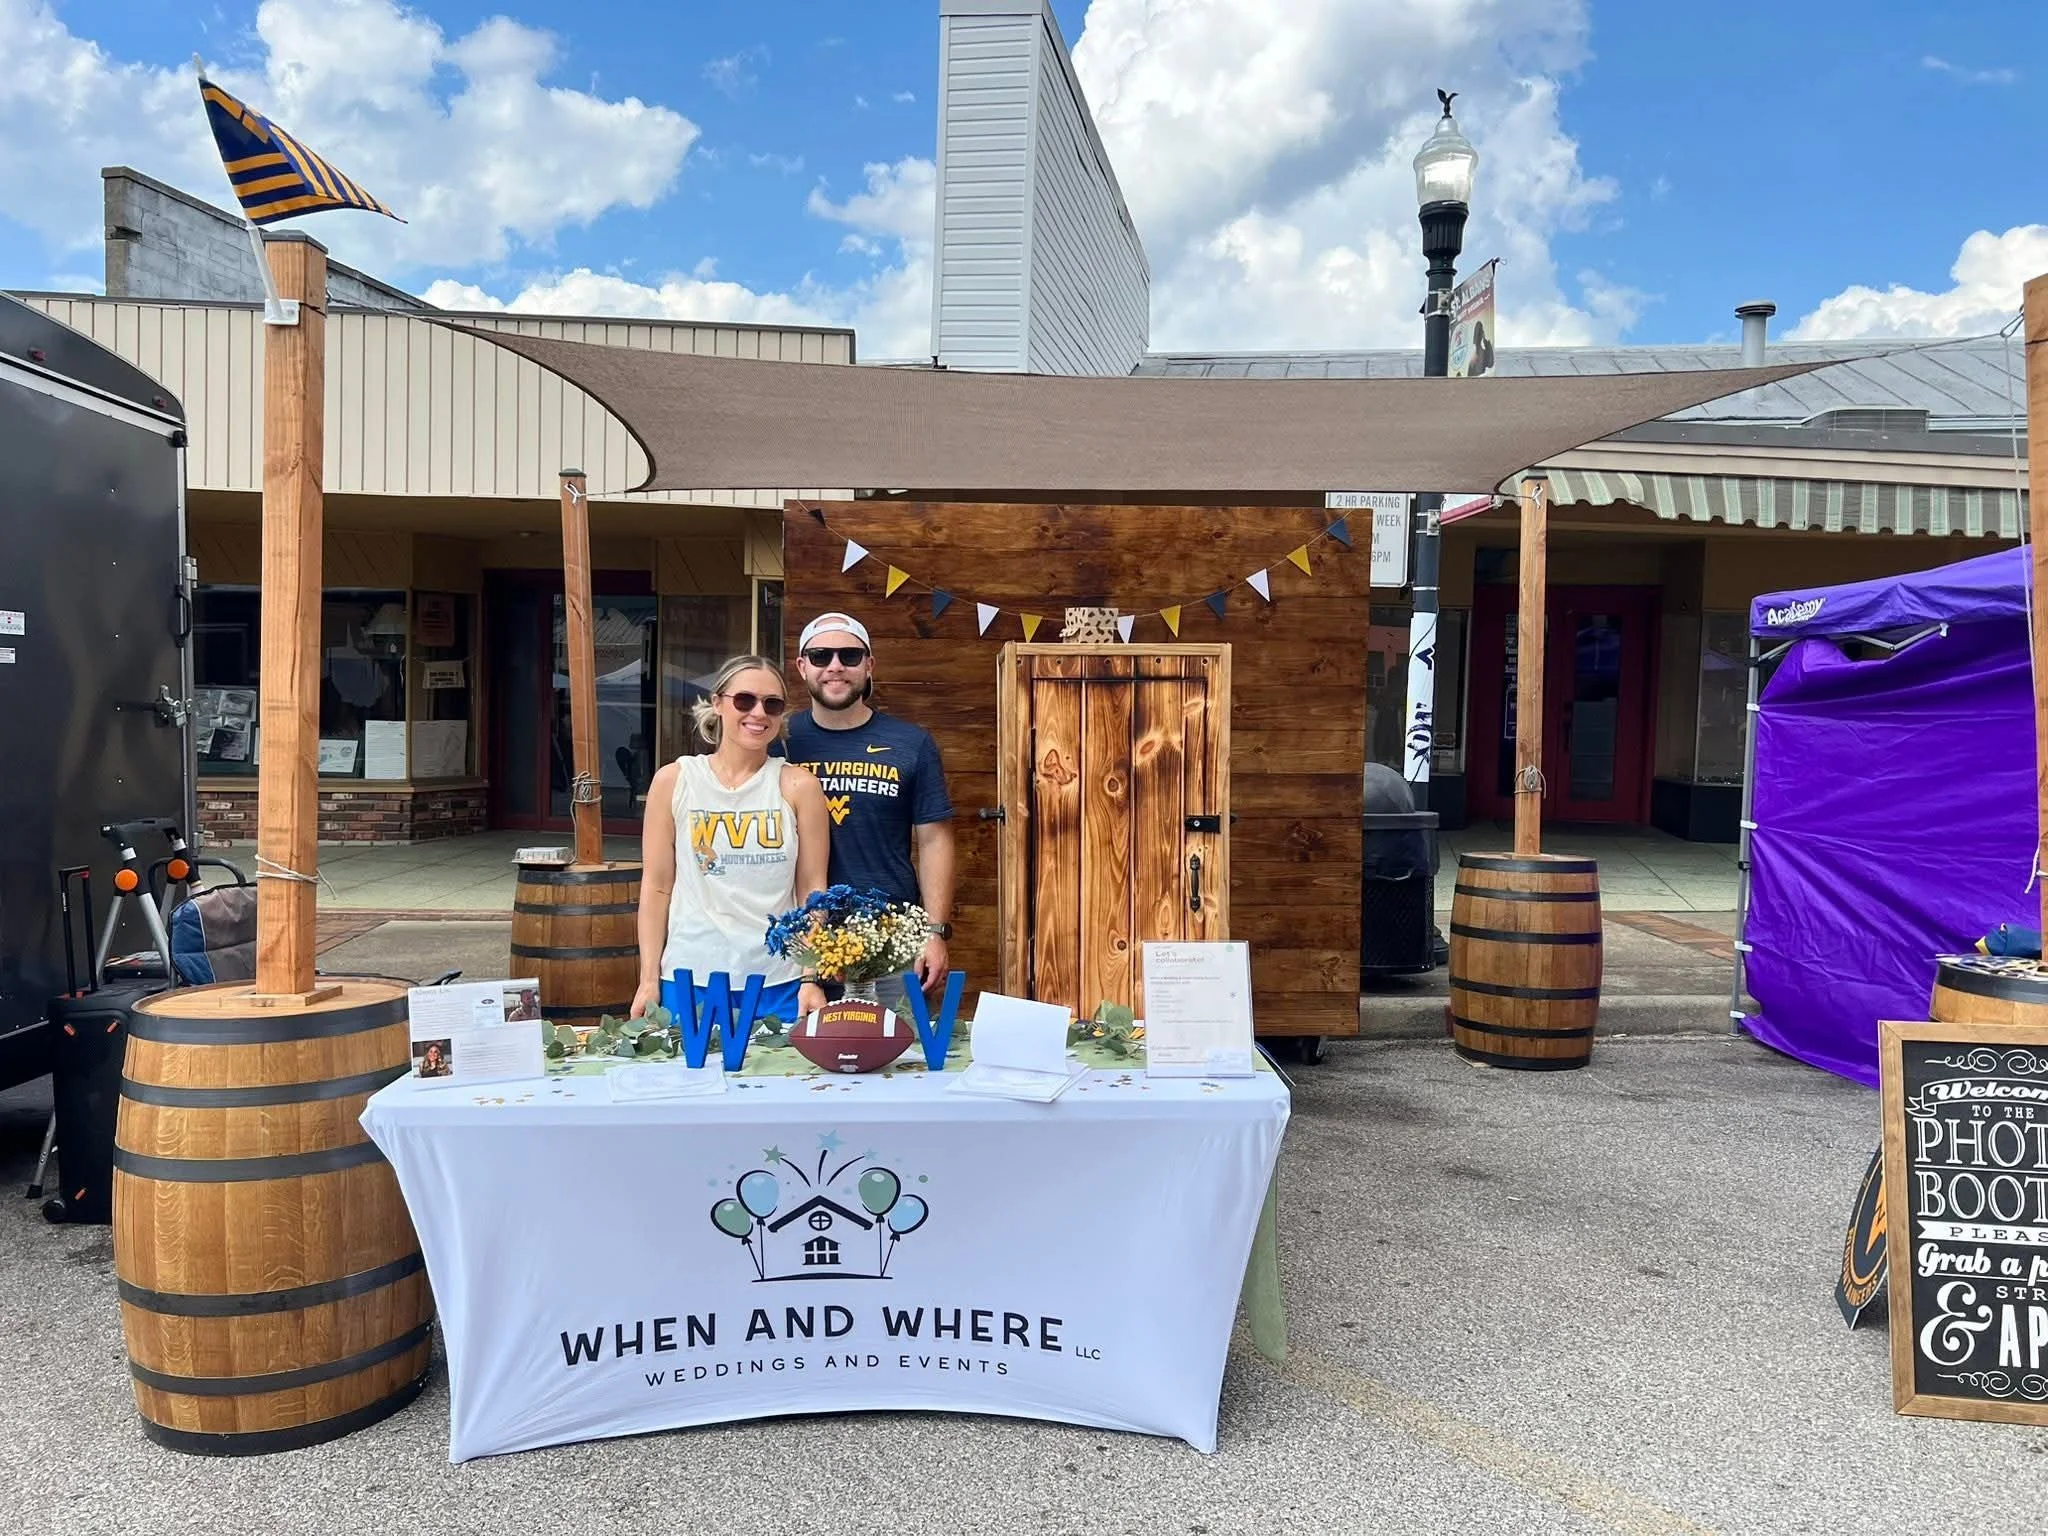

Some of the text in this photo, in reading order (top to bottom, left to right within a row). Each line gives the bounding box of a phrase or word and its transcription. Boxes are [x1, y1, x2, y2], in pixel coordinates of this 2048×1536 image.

[1336, 495, 1400, 508] 2 HR PARKING
[1376, 514, 1401, 527] WEEK
[1767, 598, 1824, 625] Academy
[824, 762, 899, 781] VIRGINIA
[820, 778, 899, 797] TAINEERS
[688, 809, 784, 849] WVU
[720, 852, 787, 865] MOUNTAINEERS
[674, 968, 966, 1072] W V
[823, 1010, 878, 1024] WEST VIRGINIA
[1972, 1105, 2034, 1119] TO THE
[1913, 1117, 2048, 1168] PHOT
[1915, 1171, 2048, 1223] BOOT
[1950, 1226, 2048, 1243] PLEAS
[1918, 1242, 1992, 1277] Grab
[2000, 1257, 2022, 1276] a
[1996, 1286, 2048, 1301] STR
[1920, 1281, 1993, 1366] &
[561, 1305, 1101, 1367] WHEN AND WHERE LLC
[645, 1355, 1008, 1387] WEDDINGS AND EVENTS
